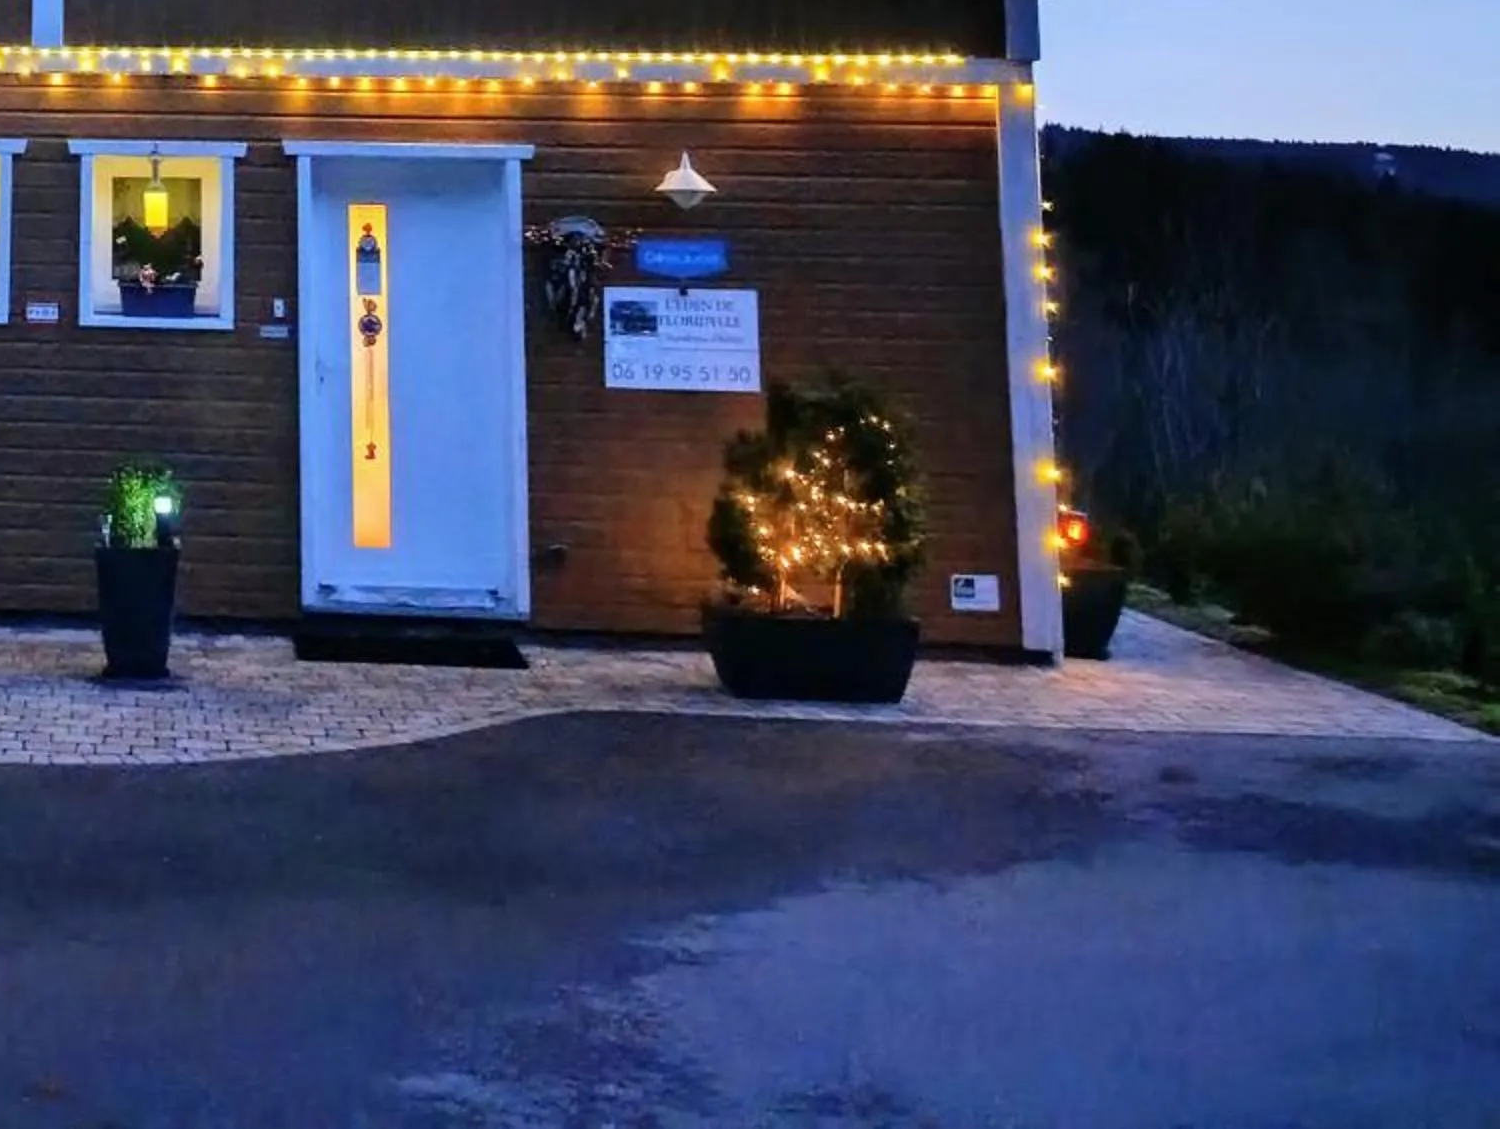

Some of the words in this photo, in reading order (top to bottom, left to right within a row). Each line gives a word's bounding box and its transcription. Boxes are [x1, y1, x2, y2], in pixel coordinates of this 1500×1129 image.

[612, 363, 635, 380] 06
[643, 364, 663, 381] 19
[669, 365, 693, 381] 95
[699, 365, 719, 382] 51
[727, 366, 751, 383] 50
